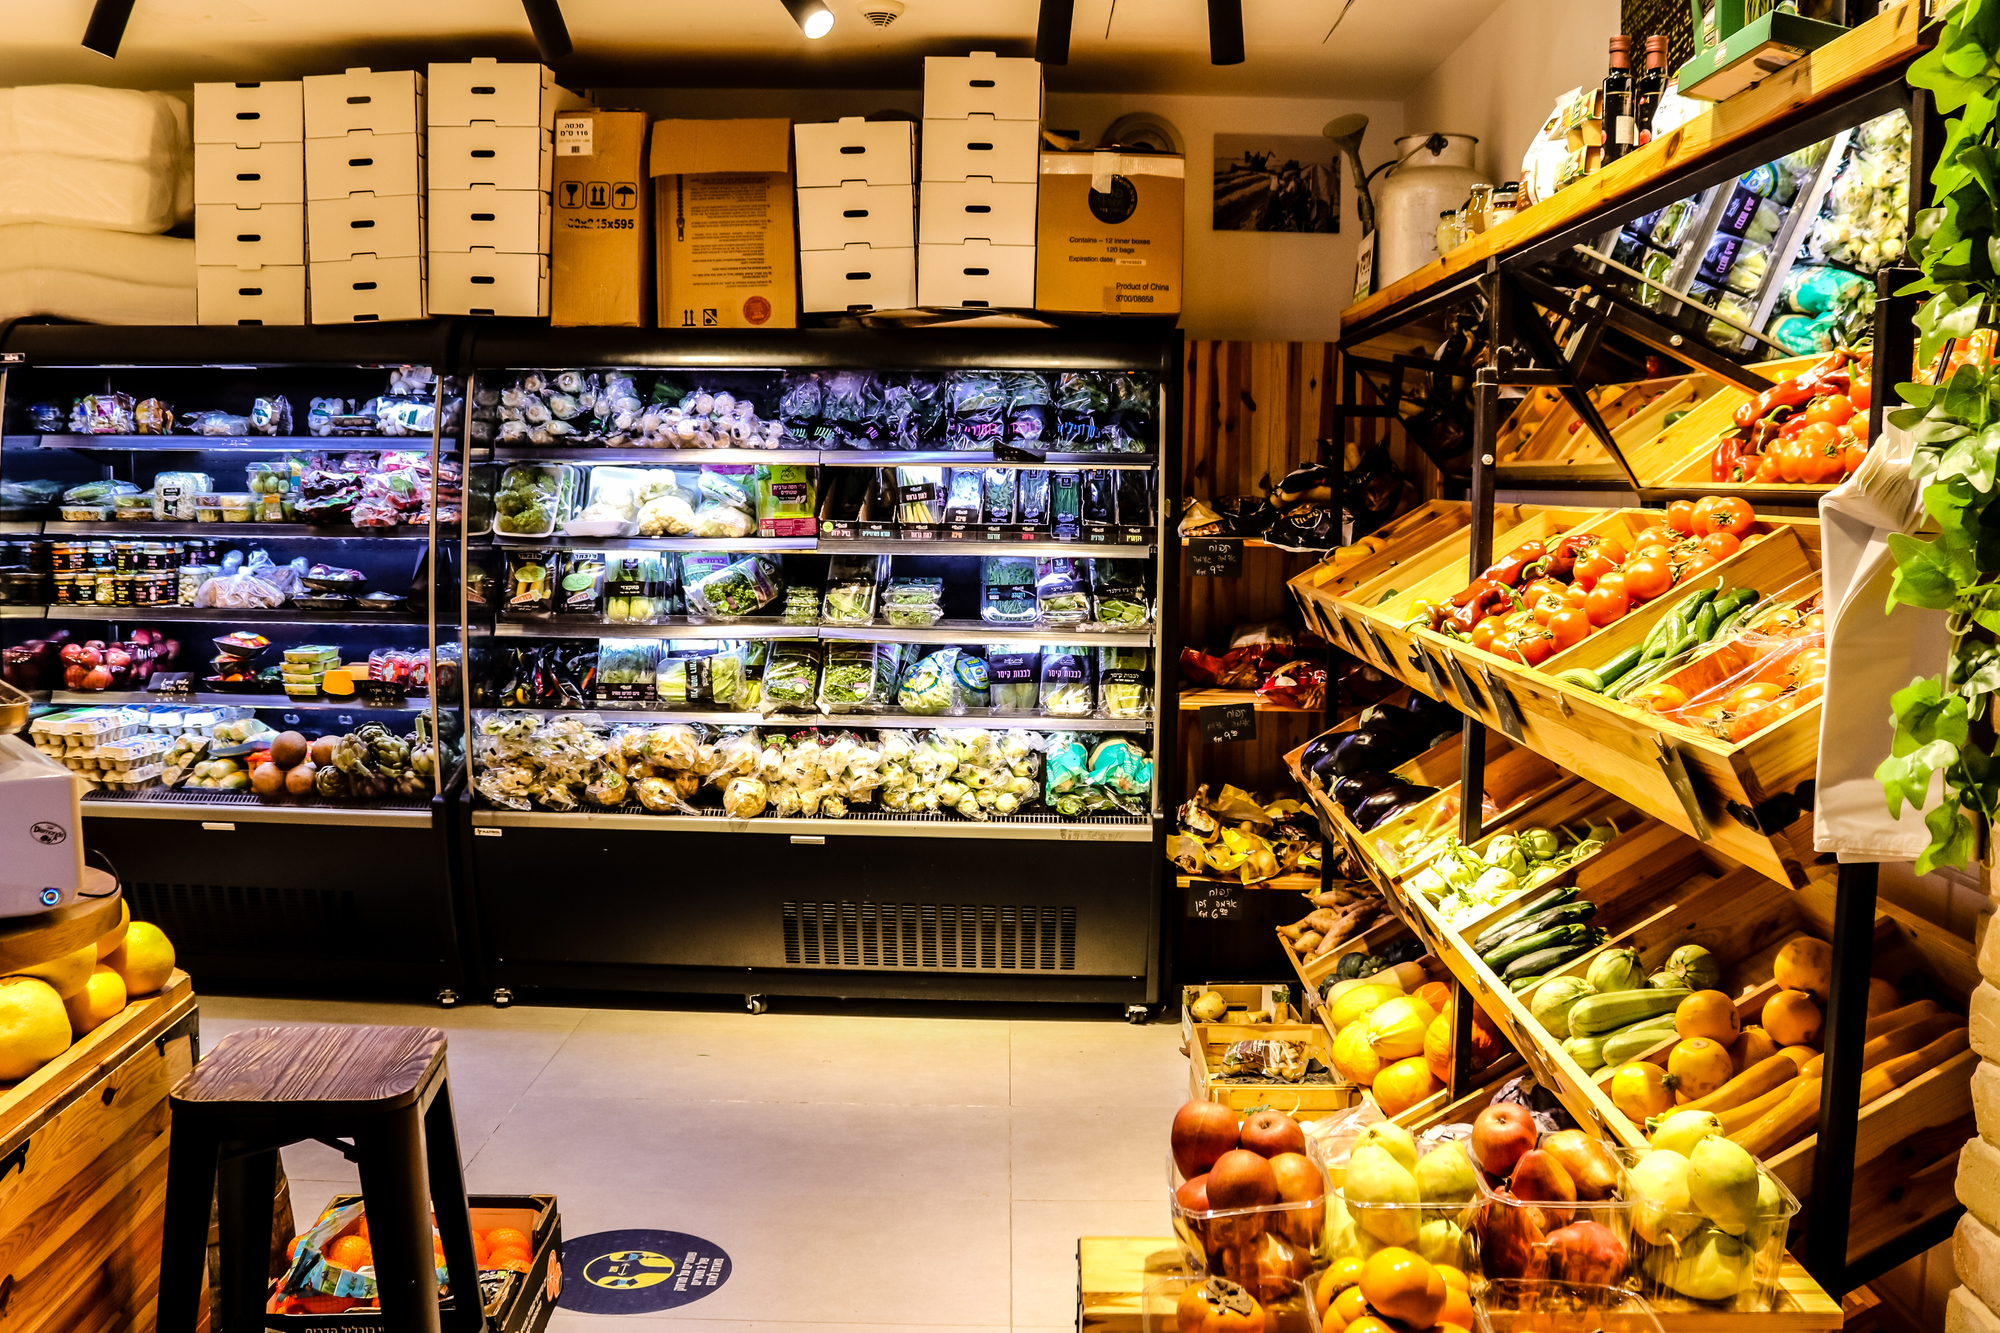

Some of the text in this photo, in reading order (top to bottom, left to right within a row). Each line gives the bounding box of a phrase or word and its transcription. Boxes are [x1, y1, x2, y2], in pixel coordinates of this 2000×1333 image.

[1116, 282, 1141, 290] Product
[1150, 283, 1169, 291] China
[997, 669, 1031, 678] לבבות קיסר
[1048, 669, 1082, 678] לבבות קיסר
[1209, 888, 1232, 897] תפוח
